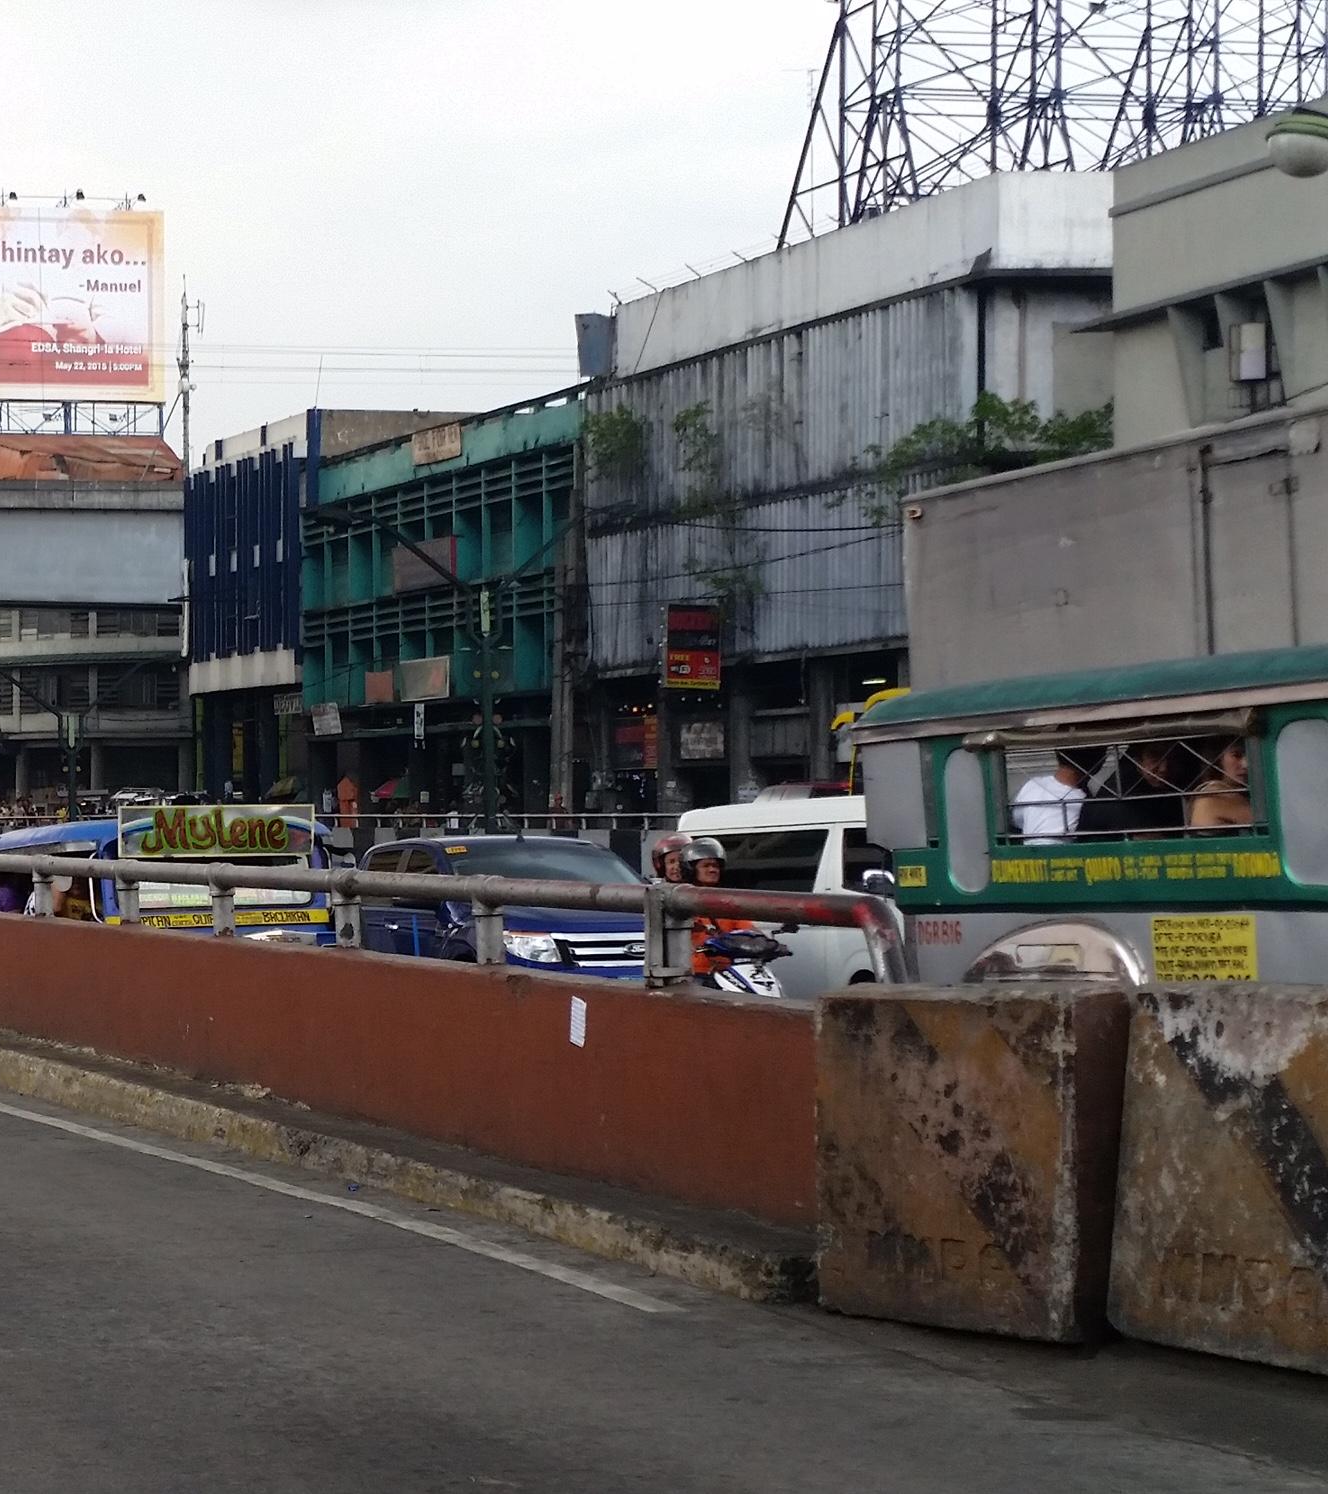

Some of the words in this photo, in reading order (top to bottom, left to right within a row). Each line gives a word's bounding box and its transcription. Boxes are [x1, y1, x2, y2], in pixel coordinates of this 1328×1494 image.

[81, 243, 147, 266] ako...
[79, 279, 142, 293] -Manuel
[31, 342, 61, 355] EDSA,
[115, 344, 142, 355] Hotel
[55, 361, 73, 372] May
[141, 808, 288, 852] Mylene
[262, 911, 311, 923] BACLARAN
